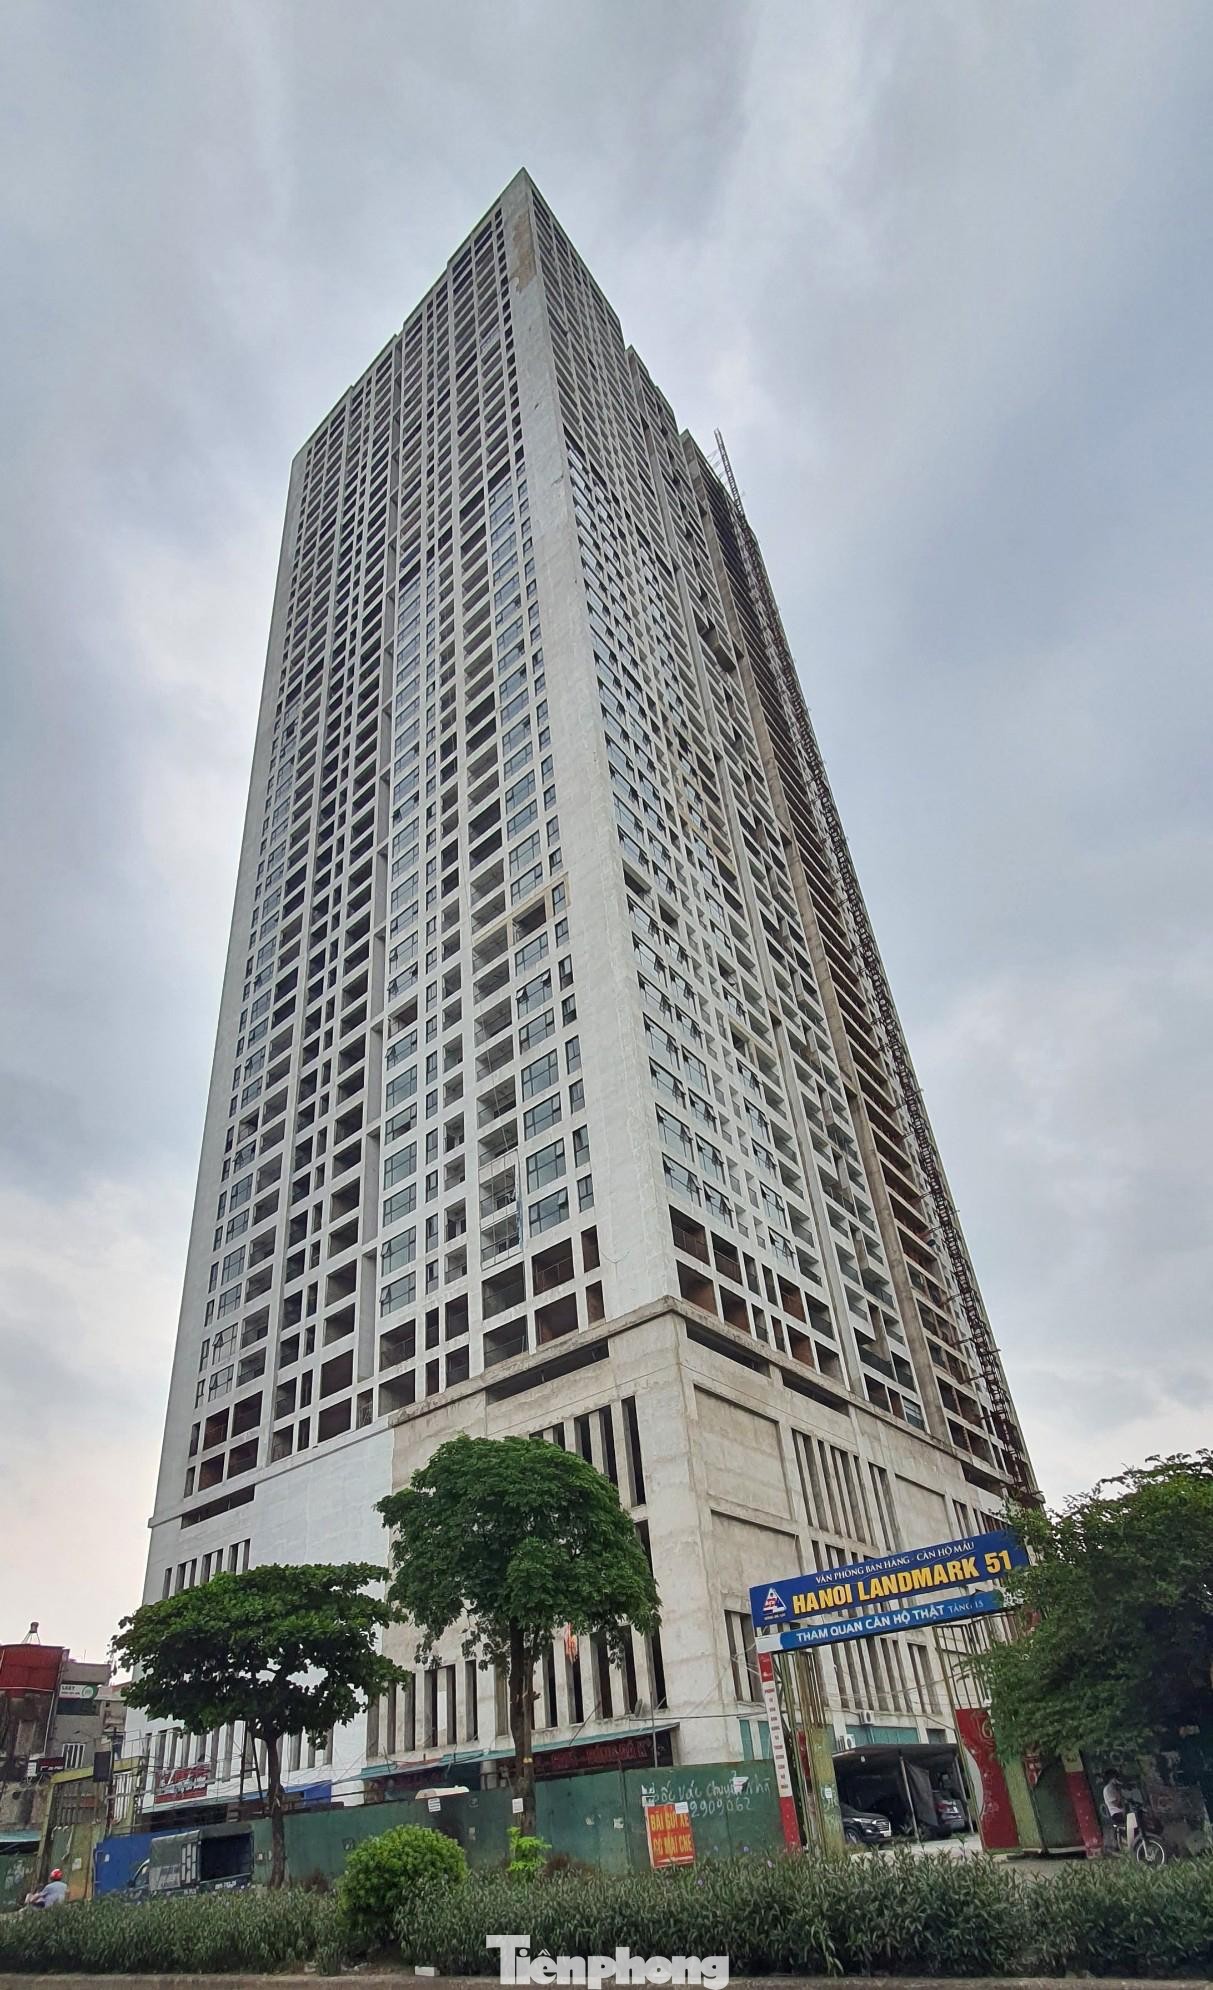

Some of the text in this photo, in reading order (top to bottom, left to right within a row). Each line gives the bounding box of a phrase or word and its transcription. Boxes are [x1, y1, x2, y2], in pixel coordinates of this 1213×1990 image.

[792, 1550, 1012, 1614] HANOI LANDMARK 51
[796, 1628, 829, 1643] THAM
[830, 1620, 863, 1636] QUAN
[865, 1614, 891, 1629] CĂN
[894, 1609, 911, 1625] HỘ
[912, 1604, 944, 1620] THẬT
